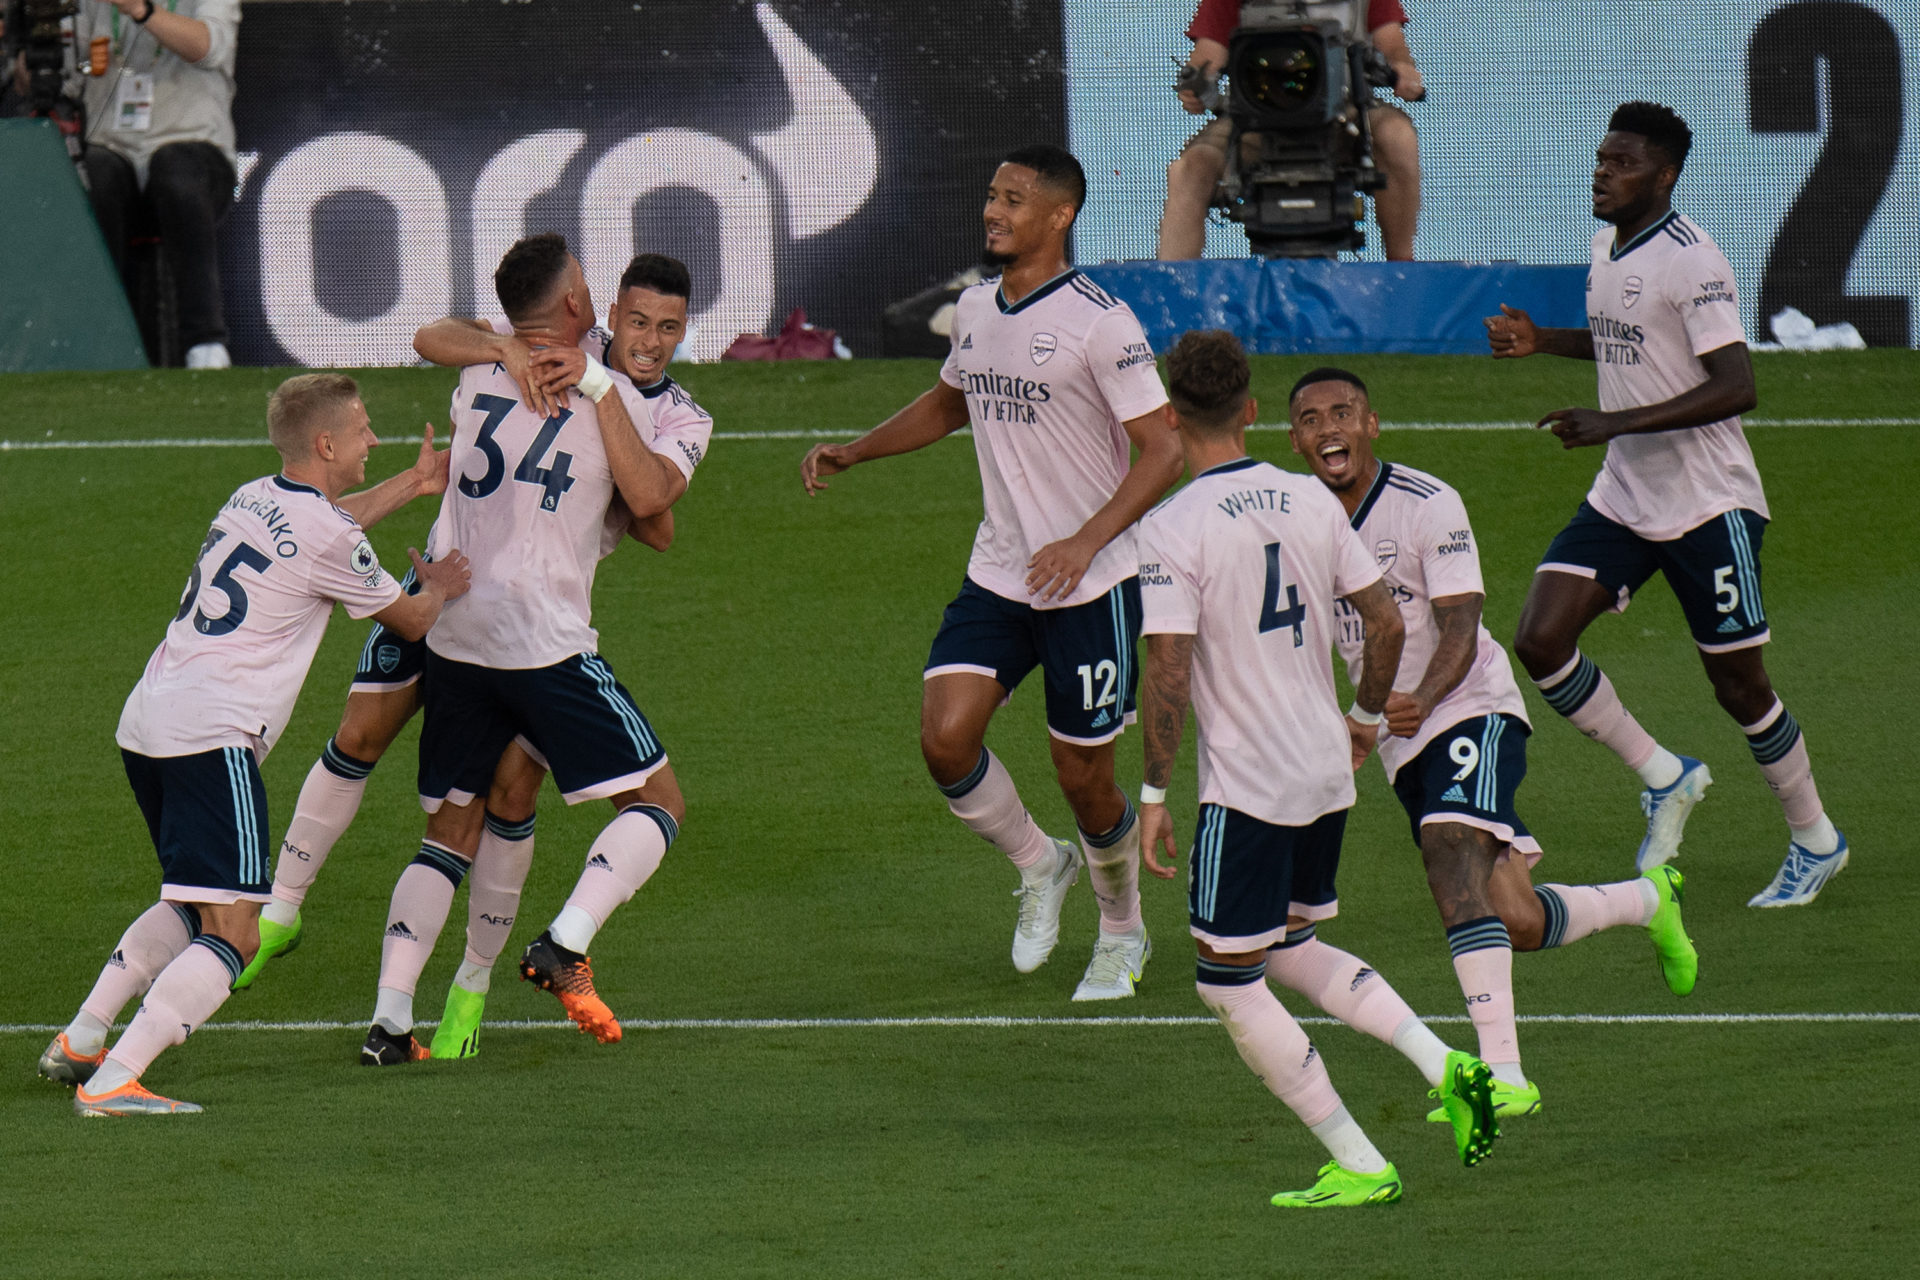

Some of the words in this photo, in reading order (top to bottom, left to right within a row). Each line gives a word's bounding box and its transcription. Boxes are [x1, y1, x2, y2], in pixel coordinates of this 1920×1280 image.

[1749, 1, 1910, 347] 2
[234, 127, 776, 368] oro
[959, 367, 1051, 403] Emirates
[457, 392, 576, 513] 34
[226, 492, 299, 559] NCHENKO
[1217, 489, 1291, 519] WHITE
[1258, 541, 1307, 649] 4
[1714, 564, 1740, 613] 5
[1077, 658, 1117, 711] 12
[1449, 736, 1480, 781] 9
[480, 912, 514, 926] AFC
